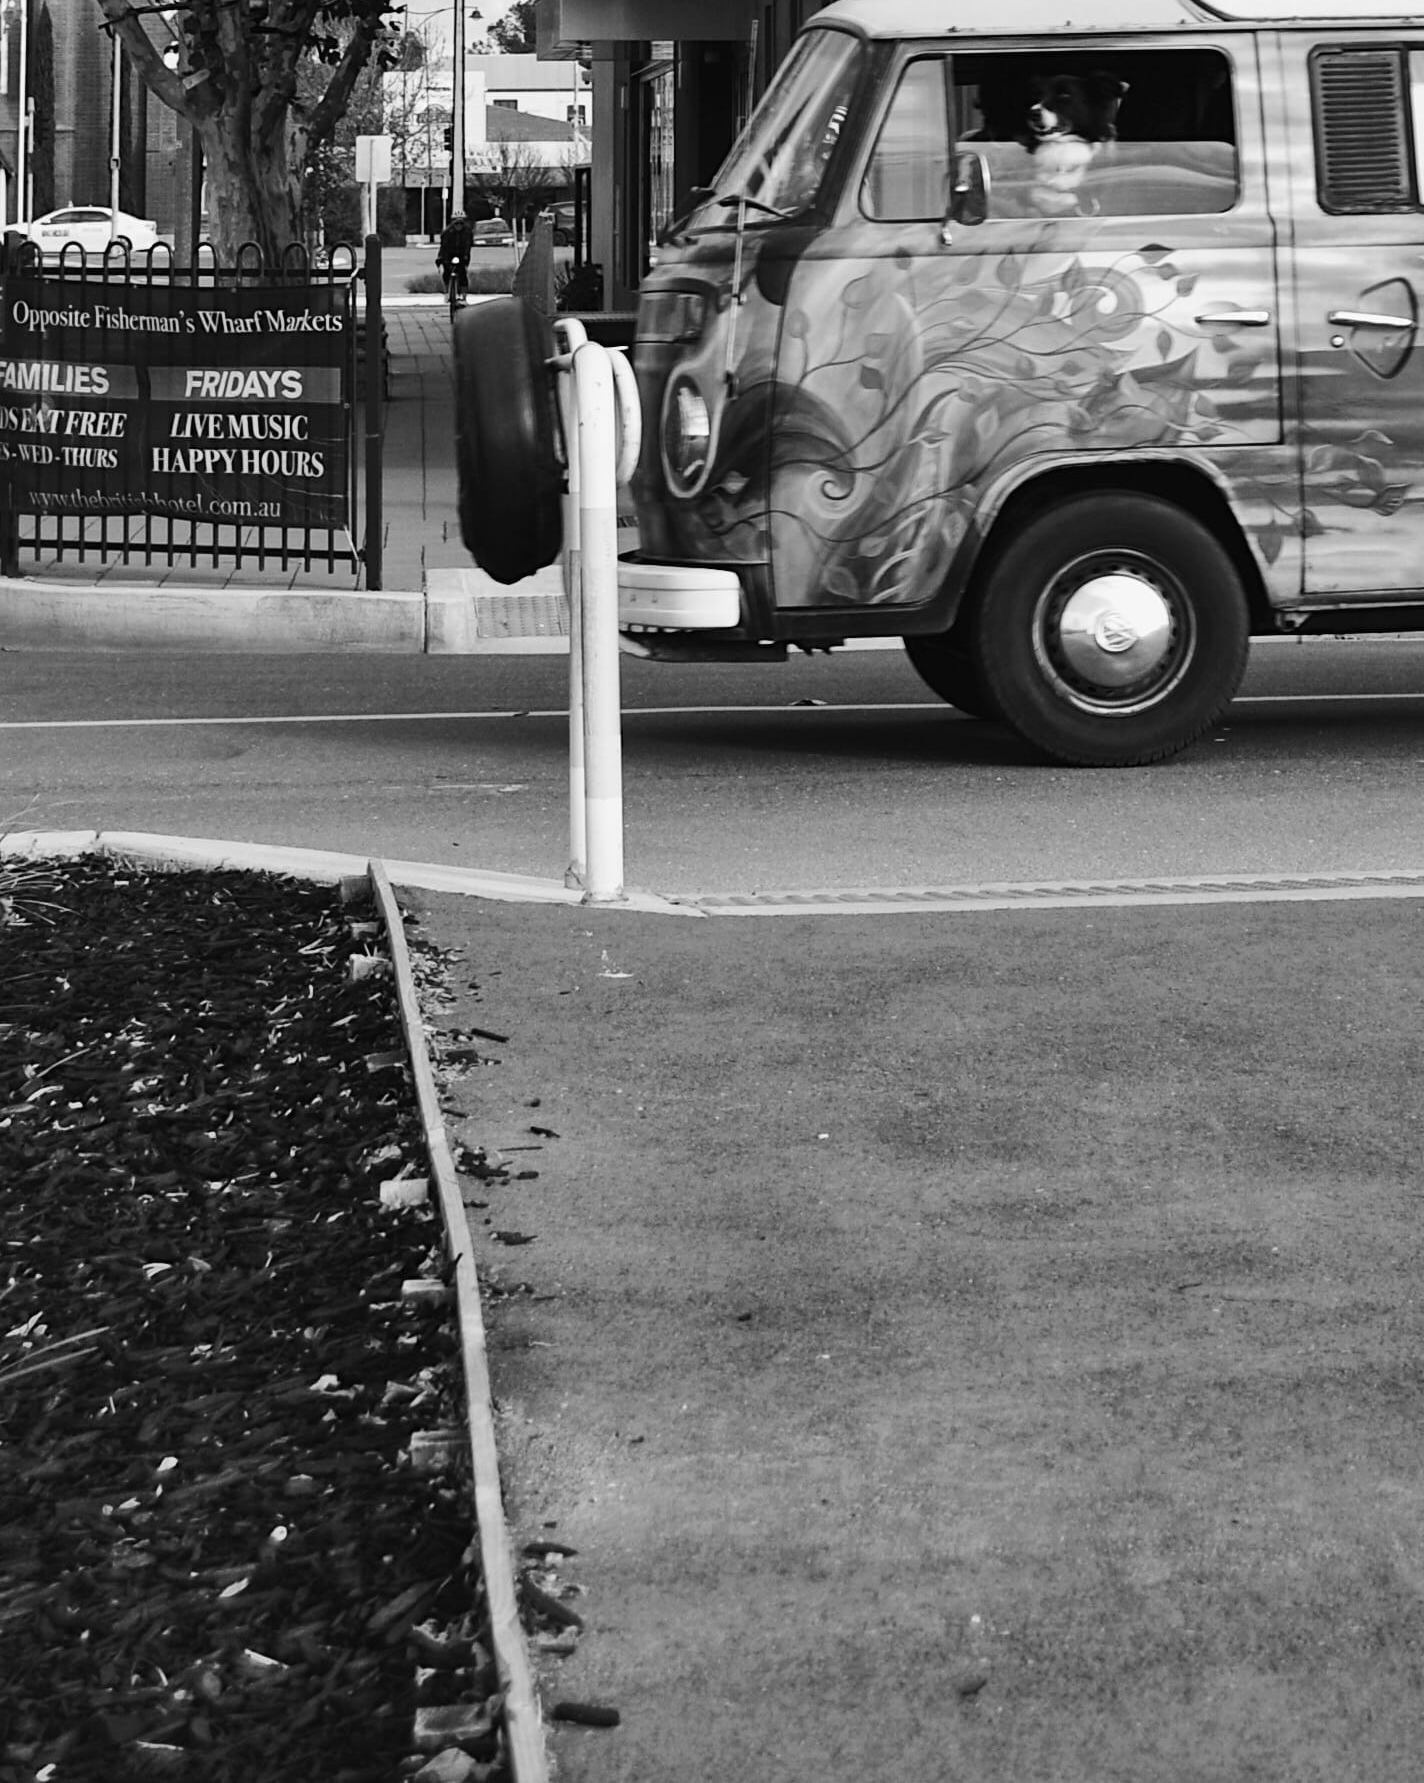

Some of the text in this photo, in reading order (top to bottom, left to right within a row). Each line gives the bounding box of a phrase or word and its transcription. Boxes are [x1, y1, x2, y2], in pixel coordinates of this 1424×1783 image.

[12, 300, 344, 334] Opposite Fisherman's Wharf Markets
[185, 369, 303, 399] FRIDAYS
[20, 407, 65, 435] EAT
[64, 410, 128, 438] FREE
[170, 412, 309, 441] LIVE MUSIC
[18, 443, 53, 465] WED
[61, 446, 118, 469] THURS
[152, 447, 325, 478] HAPPY HOURS
